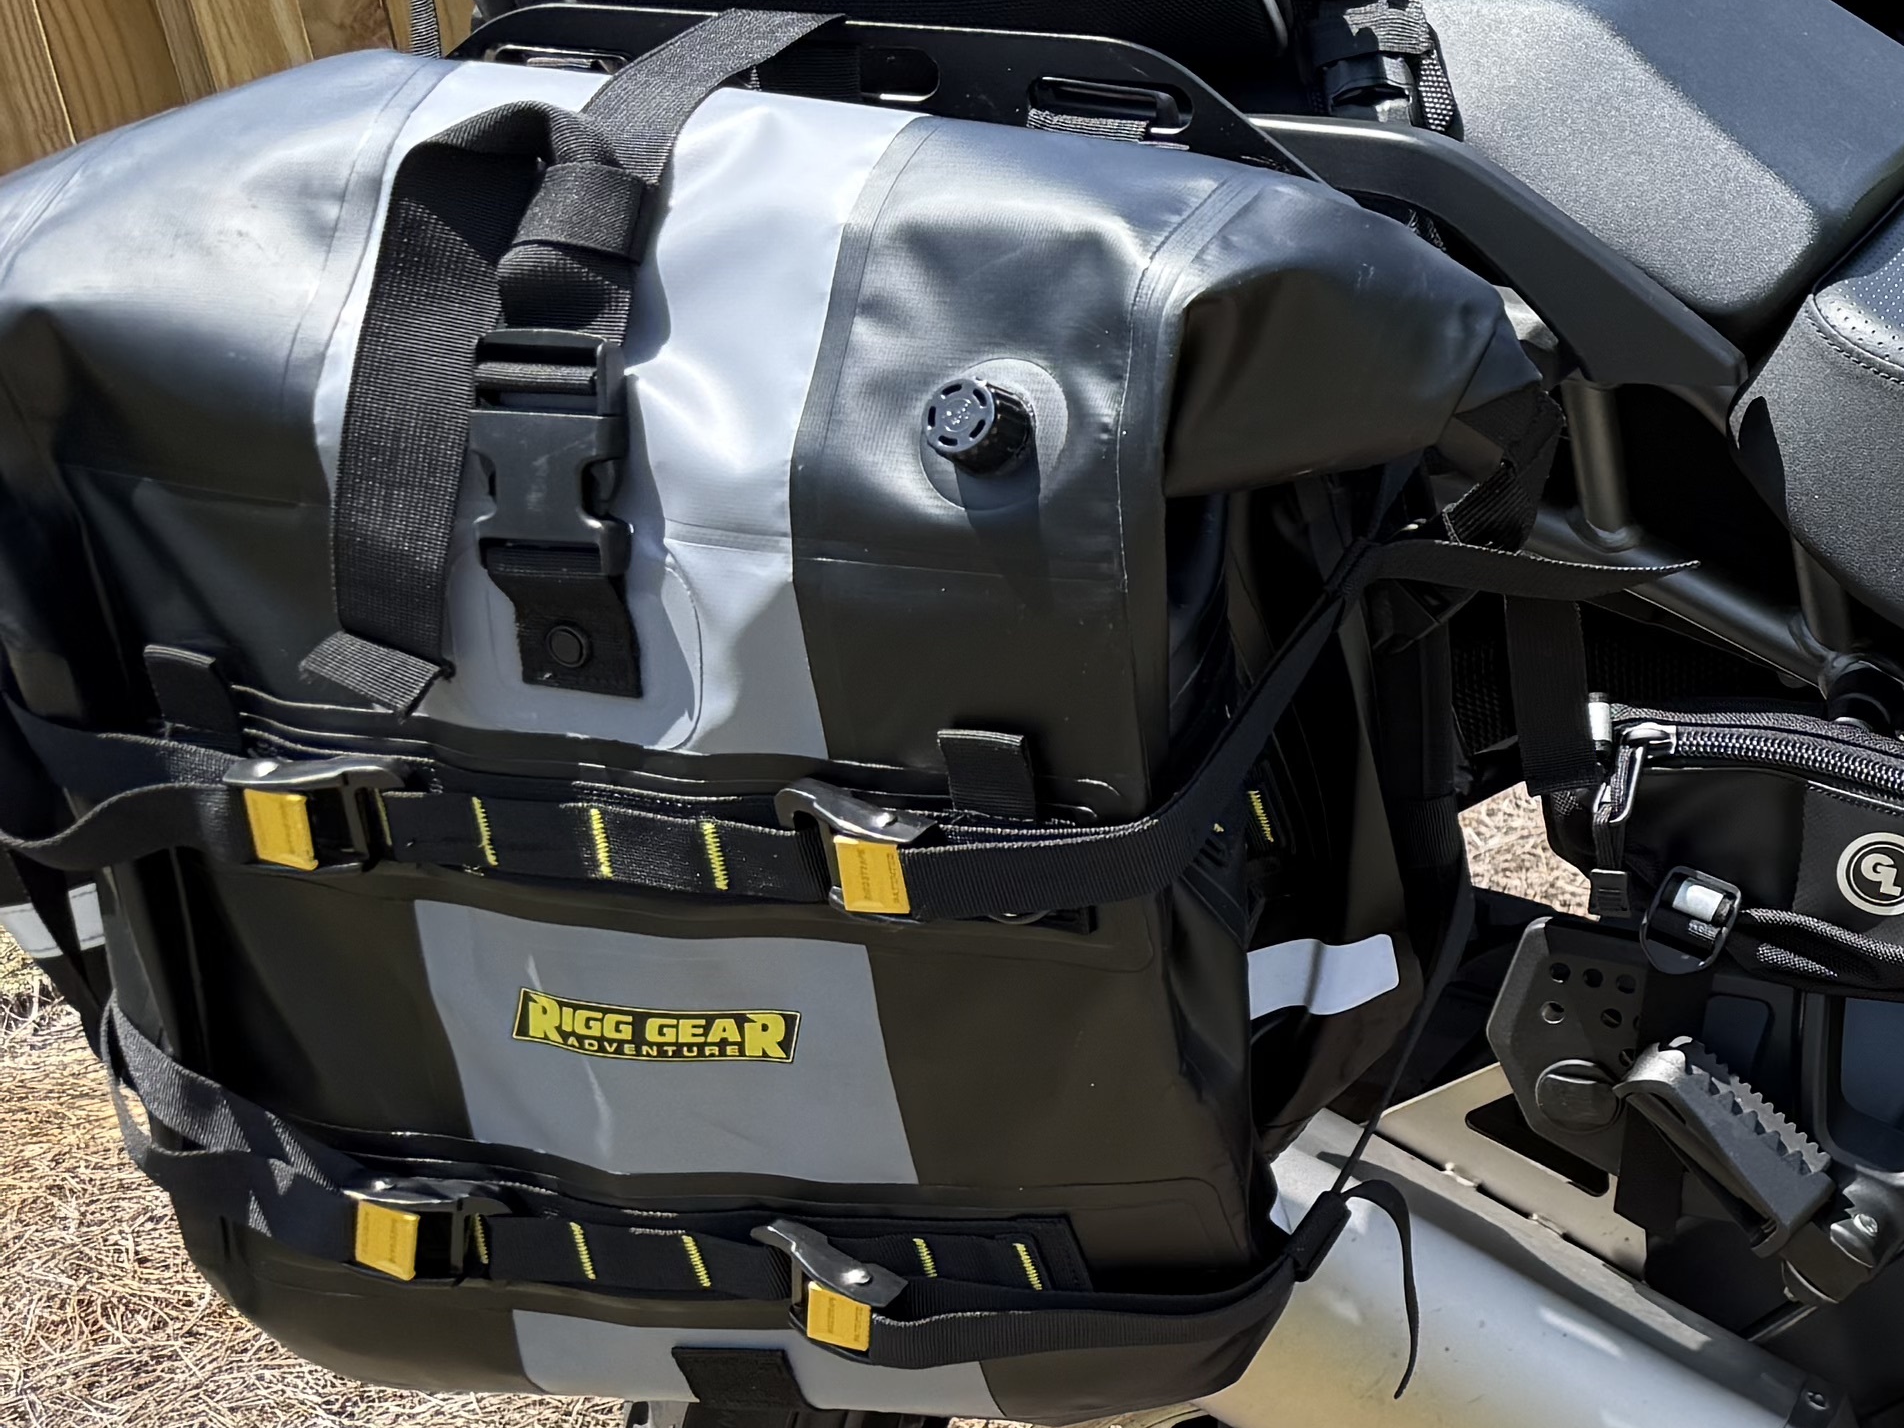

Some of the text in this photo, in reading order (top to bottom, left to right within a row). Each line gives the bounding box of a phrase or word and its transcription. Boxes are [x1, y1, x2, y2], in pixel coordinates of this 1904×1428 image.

[528, 995, 787, 1059] RIGG GEAR
[566, 1036, 740, 1057] ADVENTURE
